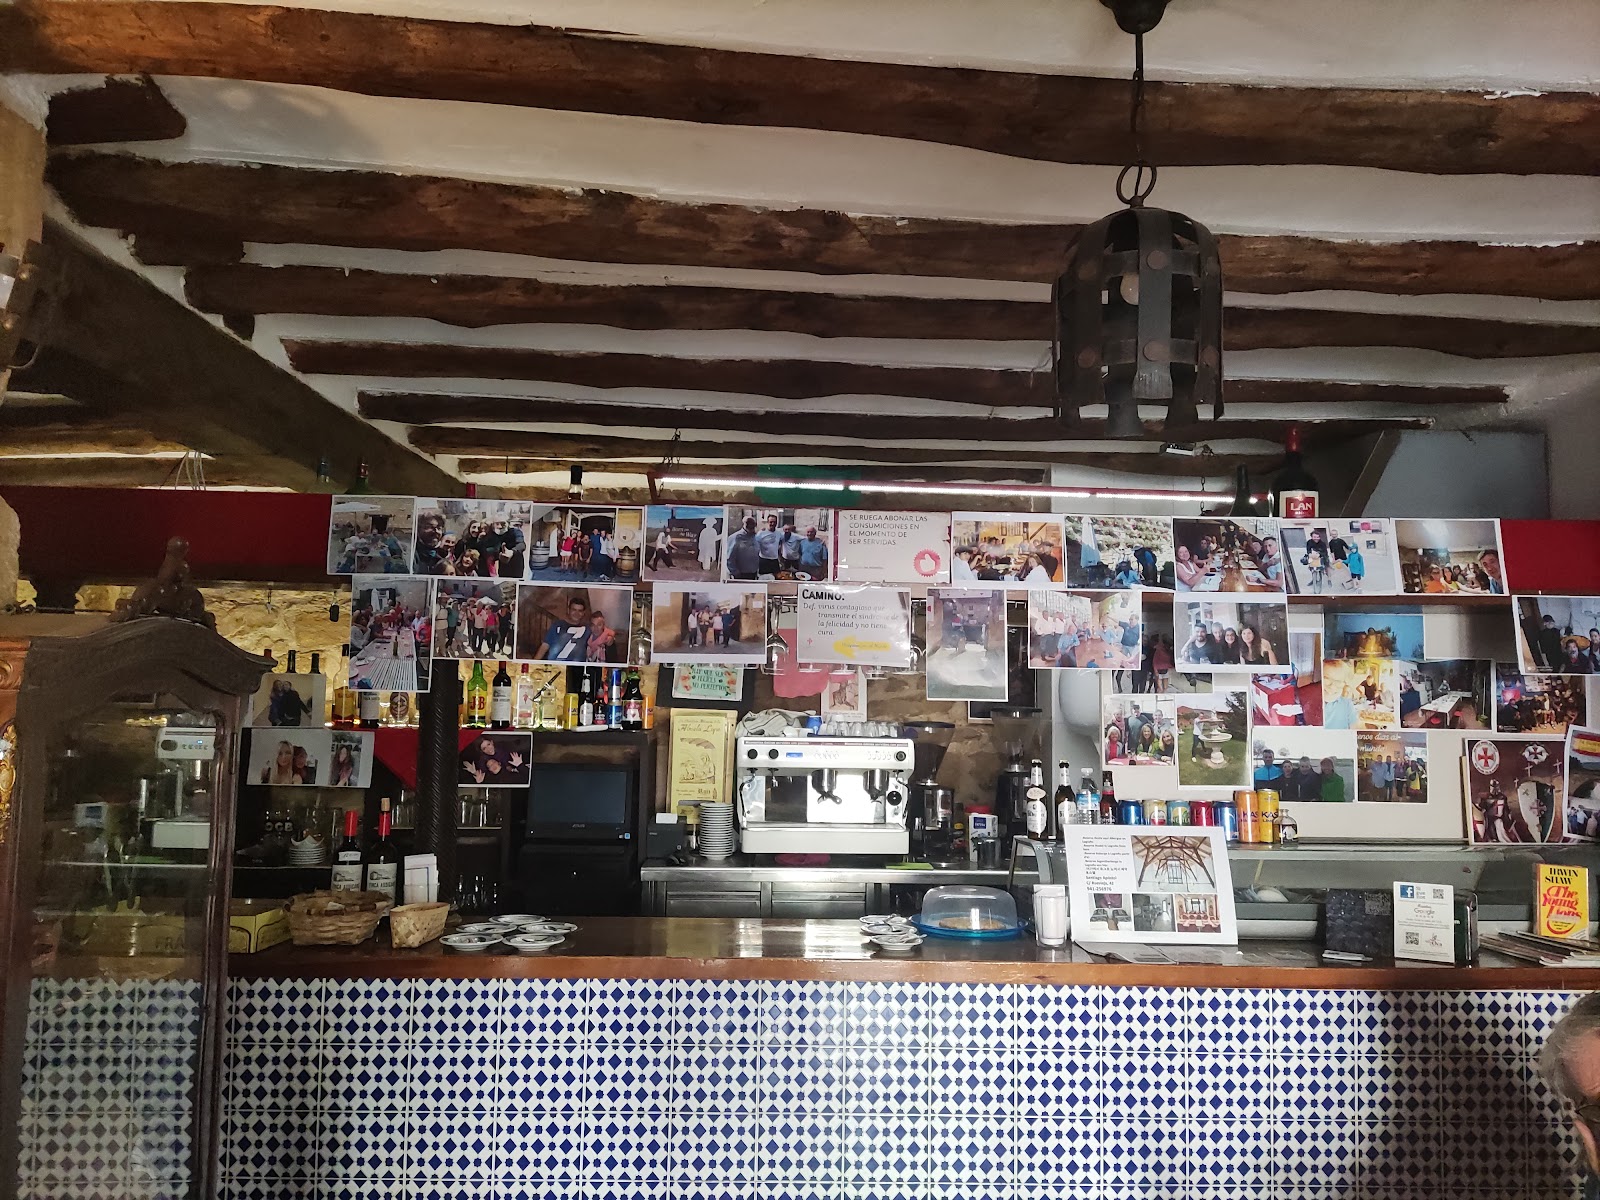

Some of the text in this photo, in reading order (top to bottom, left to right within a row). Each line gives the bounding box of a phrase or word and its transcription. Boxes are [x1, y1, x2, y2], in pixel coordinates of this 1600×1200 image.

[1290, 502, 1312, 511] LAN
[849, 522, 908, 530] CONSUMICIONES
[859, 530, 896, 538] MOMENTO
[863, 538, 896, 546] SERVIDAS
[836, 603, 872, 612] contagioso
[825, 620, 854, 628] felicidad
[470, 695, 485, 710] JB
[1261, 811, 1278, 819] KAS
[1549, 867, 1579, 877] IRWIN
[1545, 875, 1573, 885] SHAW
[1546, 885, 1579, 899] The
[1542, 893, 1579, 911] Young
[1414, 908, 1435, 916] Google
[1546, 905, 1583, 919] Lions
